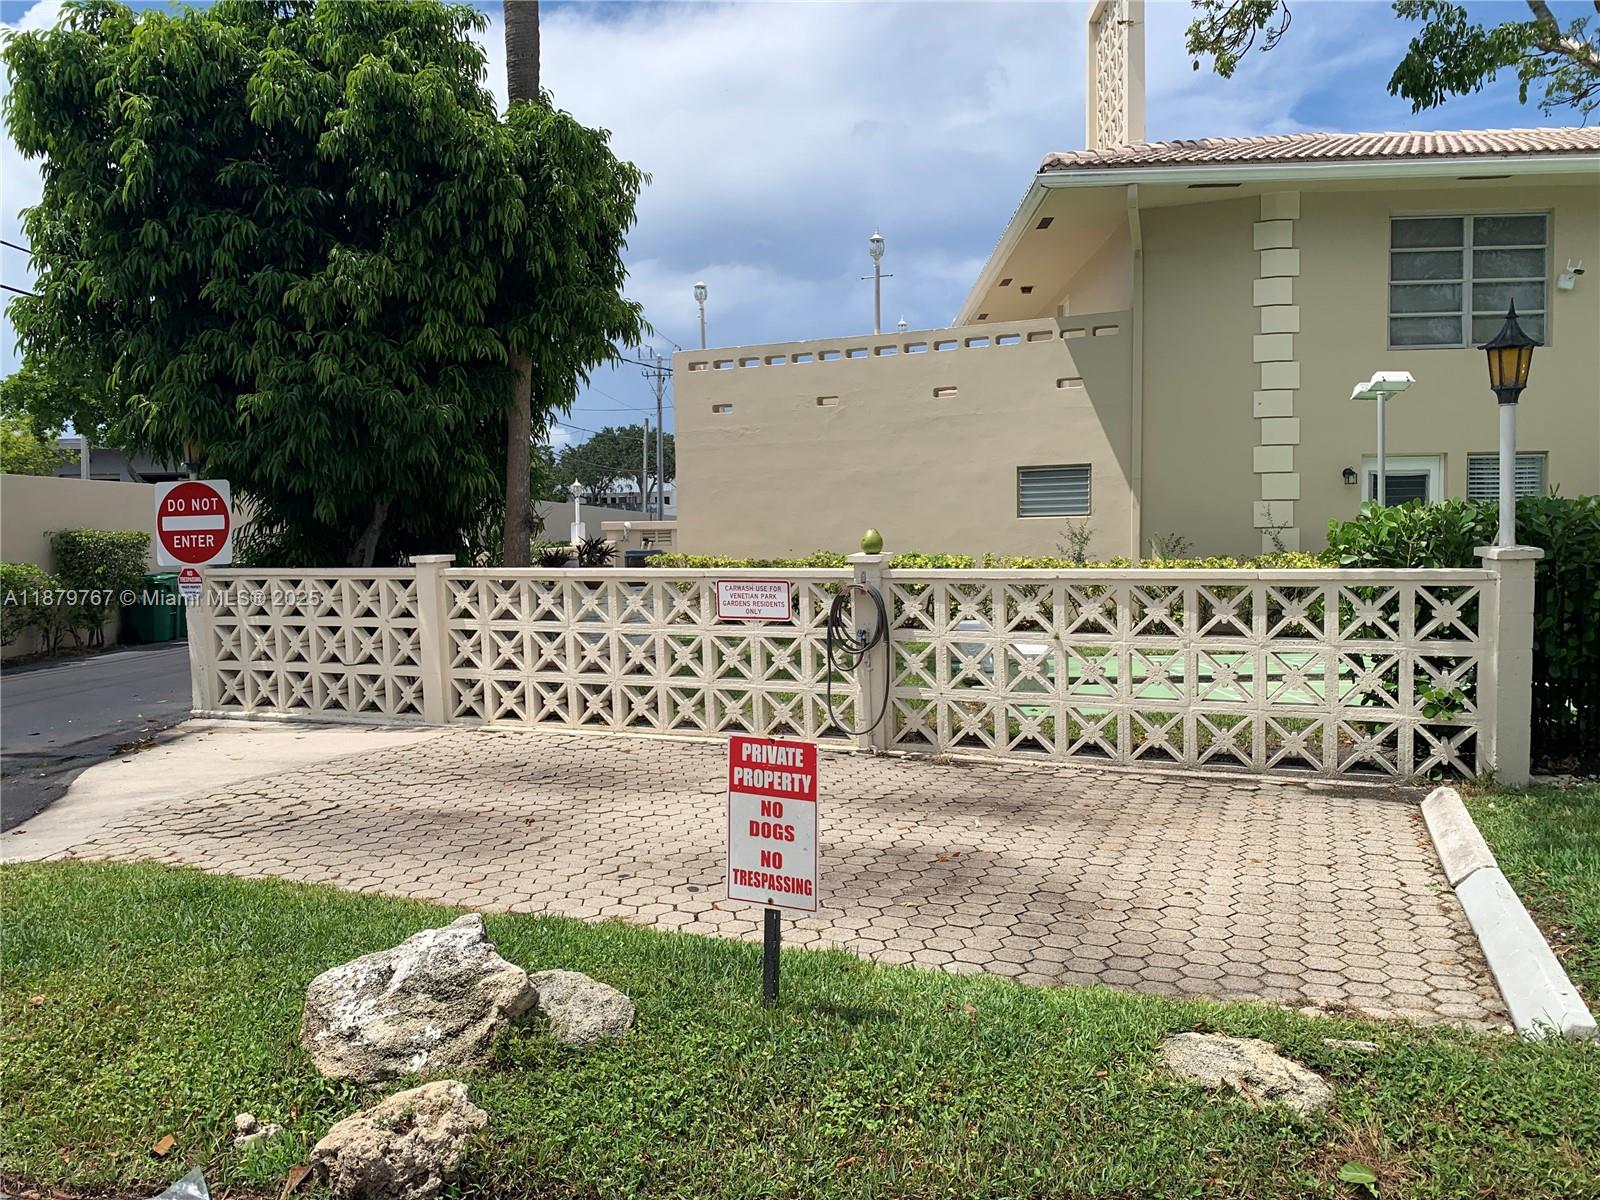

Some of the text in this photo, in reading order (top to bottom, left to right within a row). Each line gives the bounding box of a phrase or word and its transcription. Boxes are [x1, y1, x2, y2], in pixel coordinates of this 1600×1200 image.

[167, 497, 219, 512] DO NOT
[173, 534, 215, 548] ENTER
[741, 743, 804, 767] PRIVATE
[733, 766, 812, 794] PROPERTY
[761, 800, 783, 818] NO
[749, 820, 795, 841] DOGS
[760, 850, 783, 869] NO
[732, 868, 812, 896] TRESPASSING
